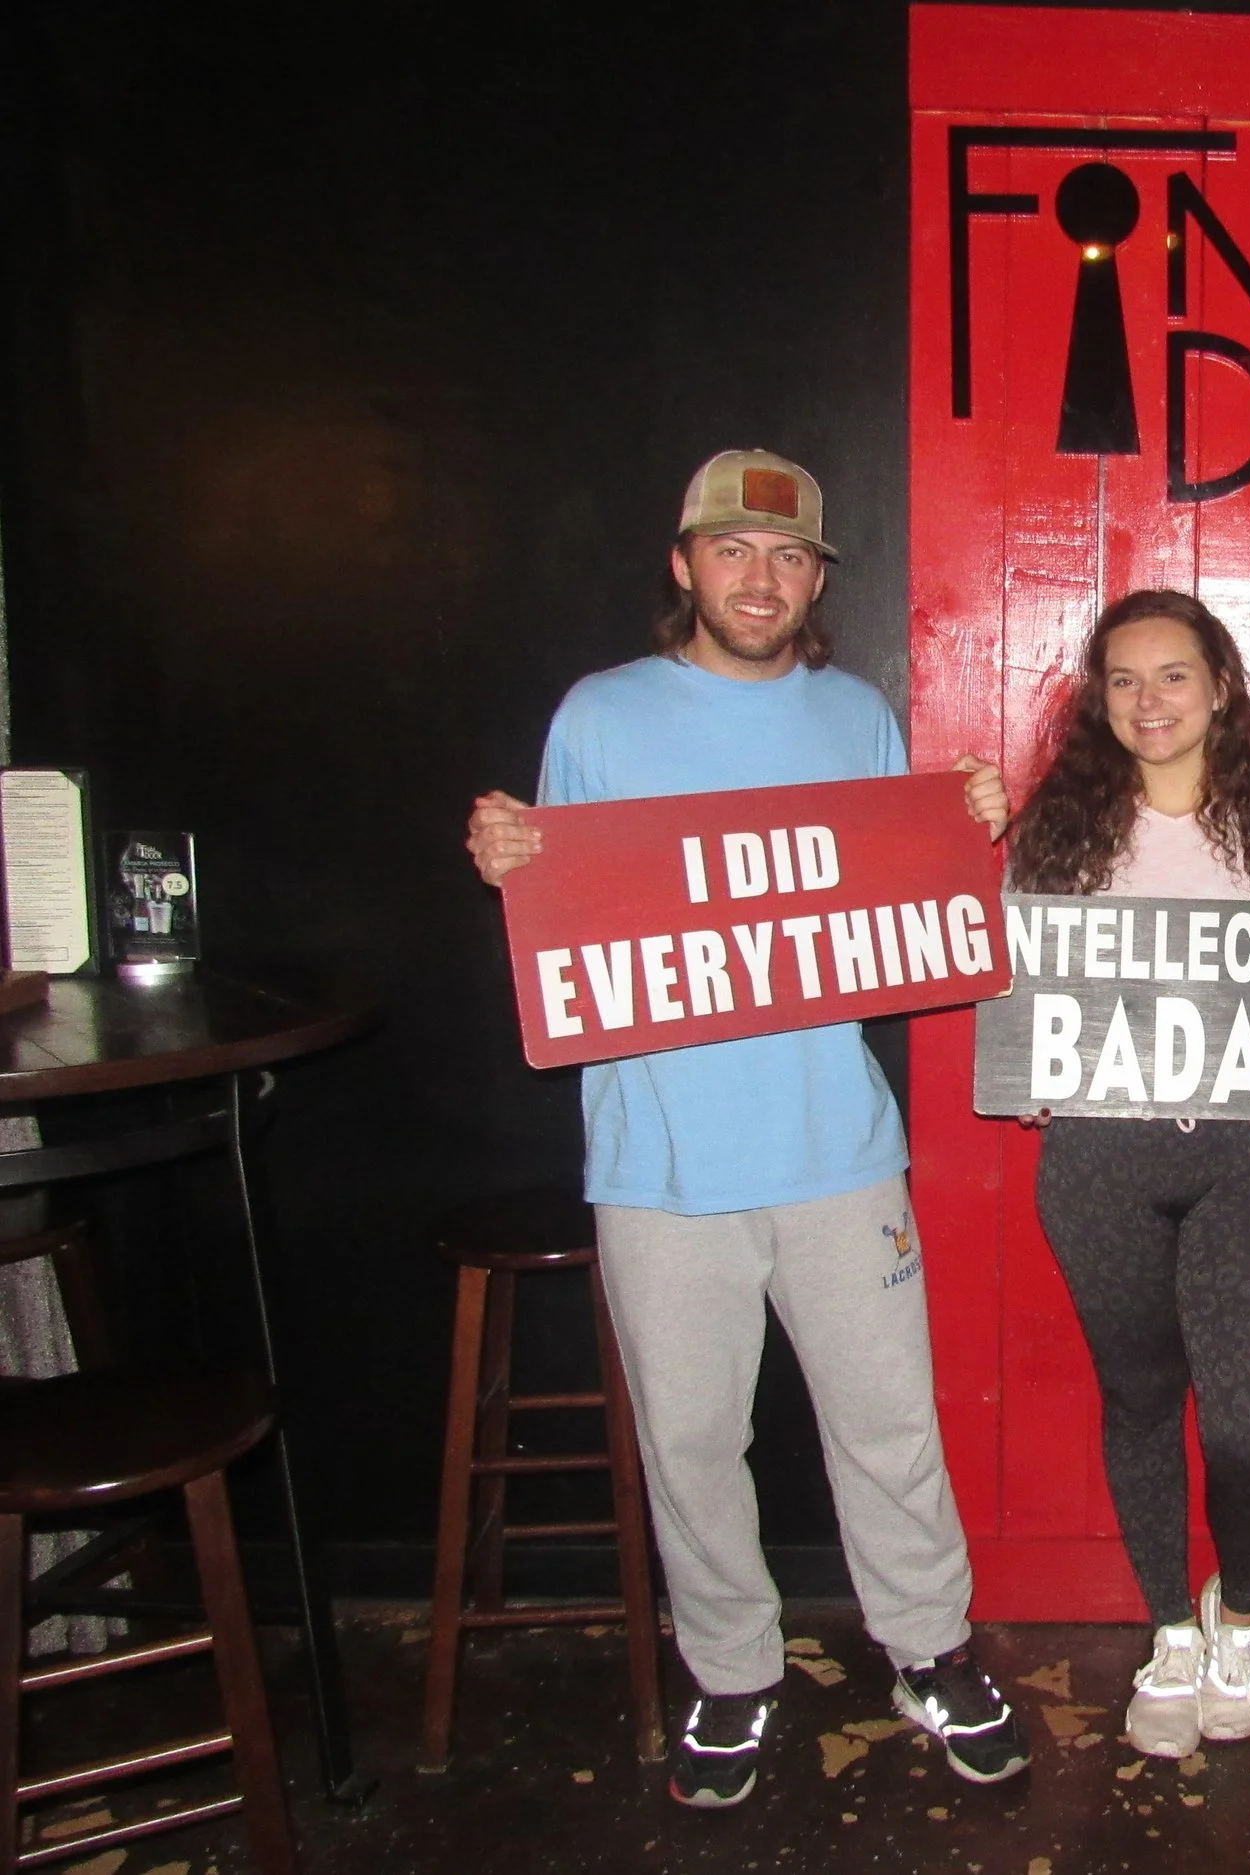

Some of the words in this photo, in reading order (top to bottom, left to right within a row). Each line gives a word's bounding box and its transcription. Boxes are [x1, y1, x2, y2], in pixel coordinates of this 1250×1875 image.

[682, 837, 708, 904] I
[723, 825, 840, 900] DID
[536, 894, 994, 1039] EVERYTHING
